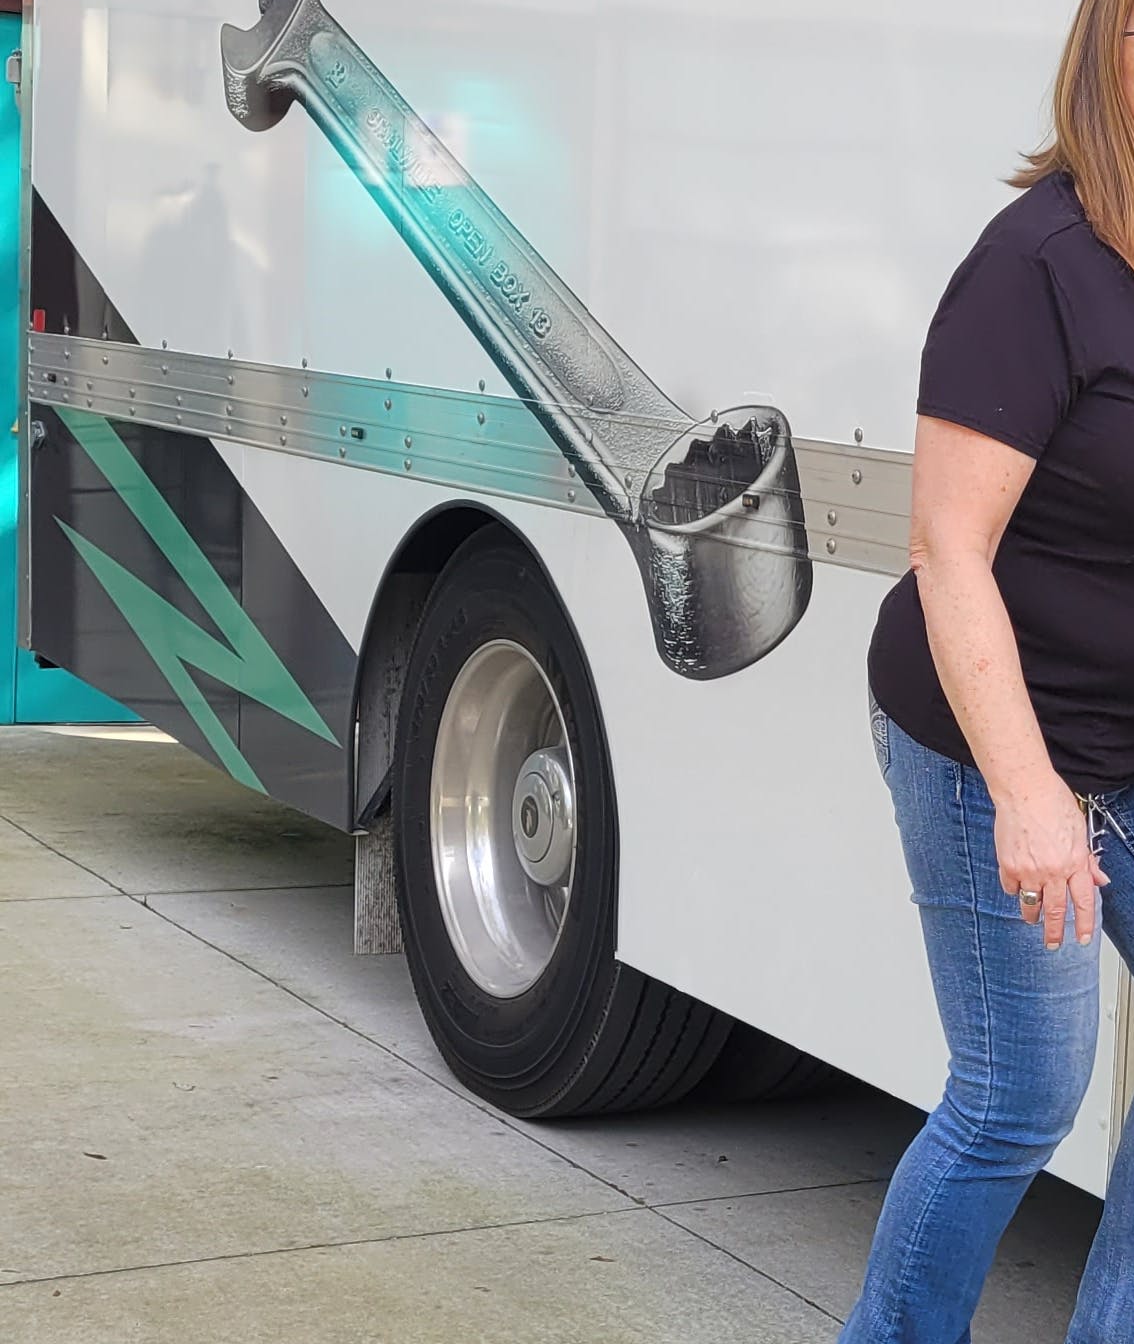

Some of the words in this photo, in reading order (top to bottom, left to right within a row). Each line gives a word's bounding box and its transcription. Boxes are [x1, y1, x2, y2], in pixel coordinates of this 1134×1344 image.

[448, 208, 493, 266] OPEN
[489, 260, 531, 314] BOX
[528, 307, 552, 339] 13
